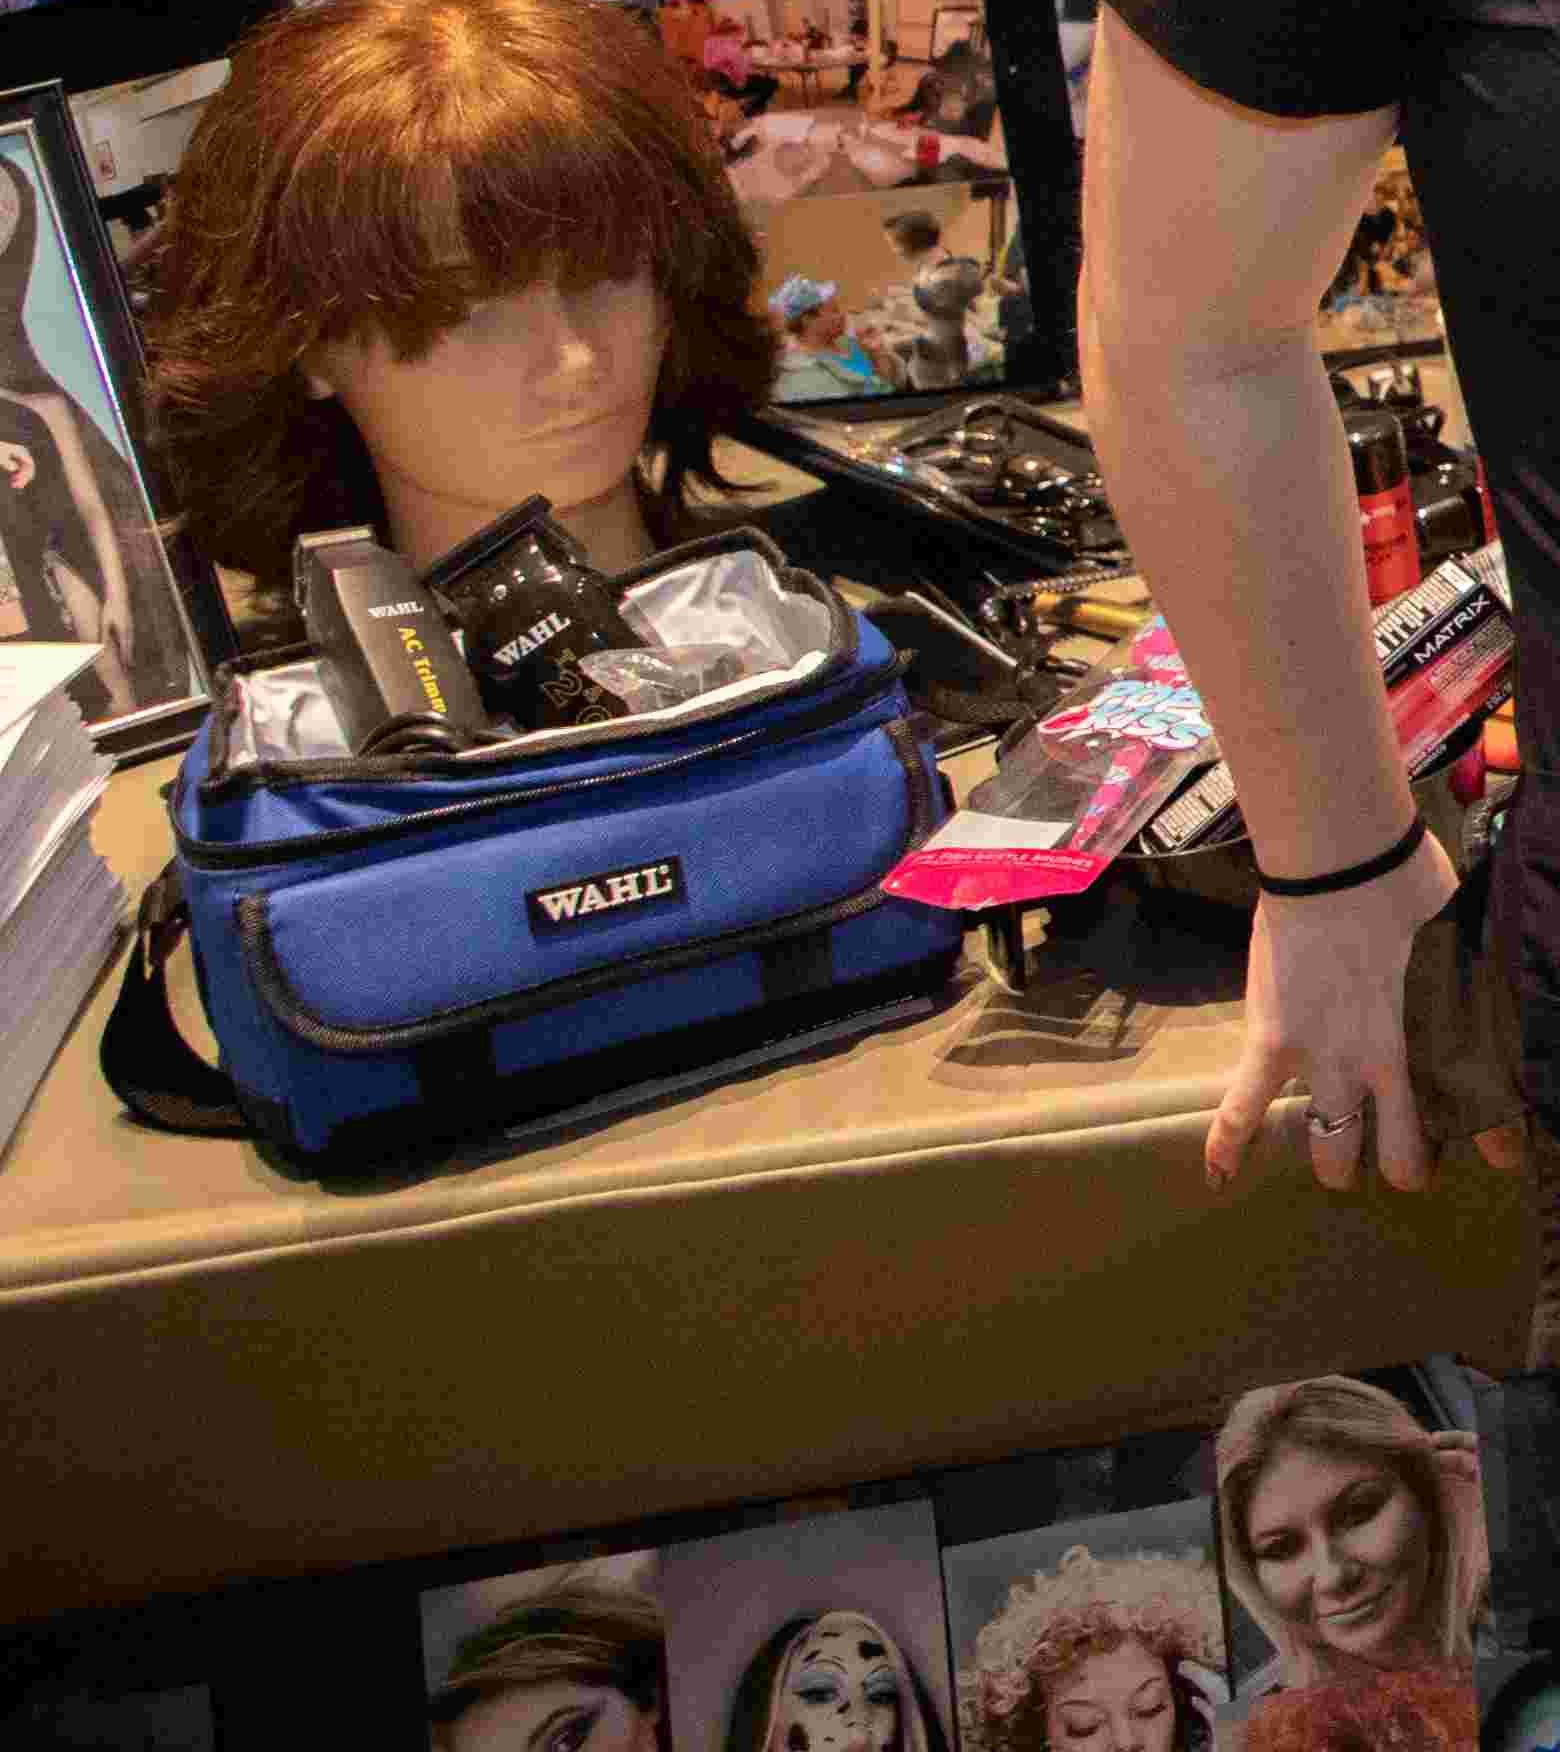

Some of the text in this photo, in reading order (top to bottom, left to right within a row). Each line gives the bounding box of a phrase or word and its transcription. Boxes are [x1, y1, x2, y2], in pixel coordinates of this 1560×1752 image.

[368, 600, 424, 619] WAHL
[1413, 591, 1491, 665] MATRIX
[398, 625, 424, 654] AC
[492, 611, 571, 666] WAHL
